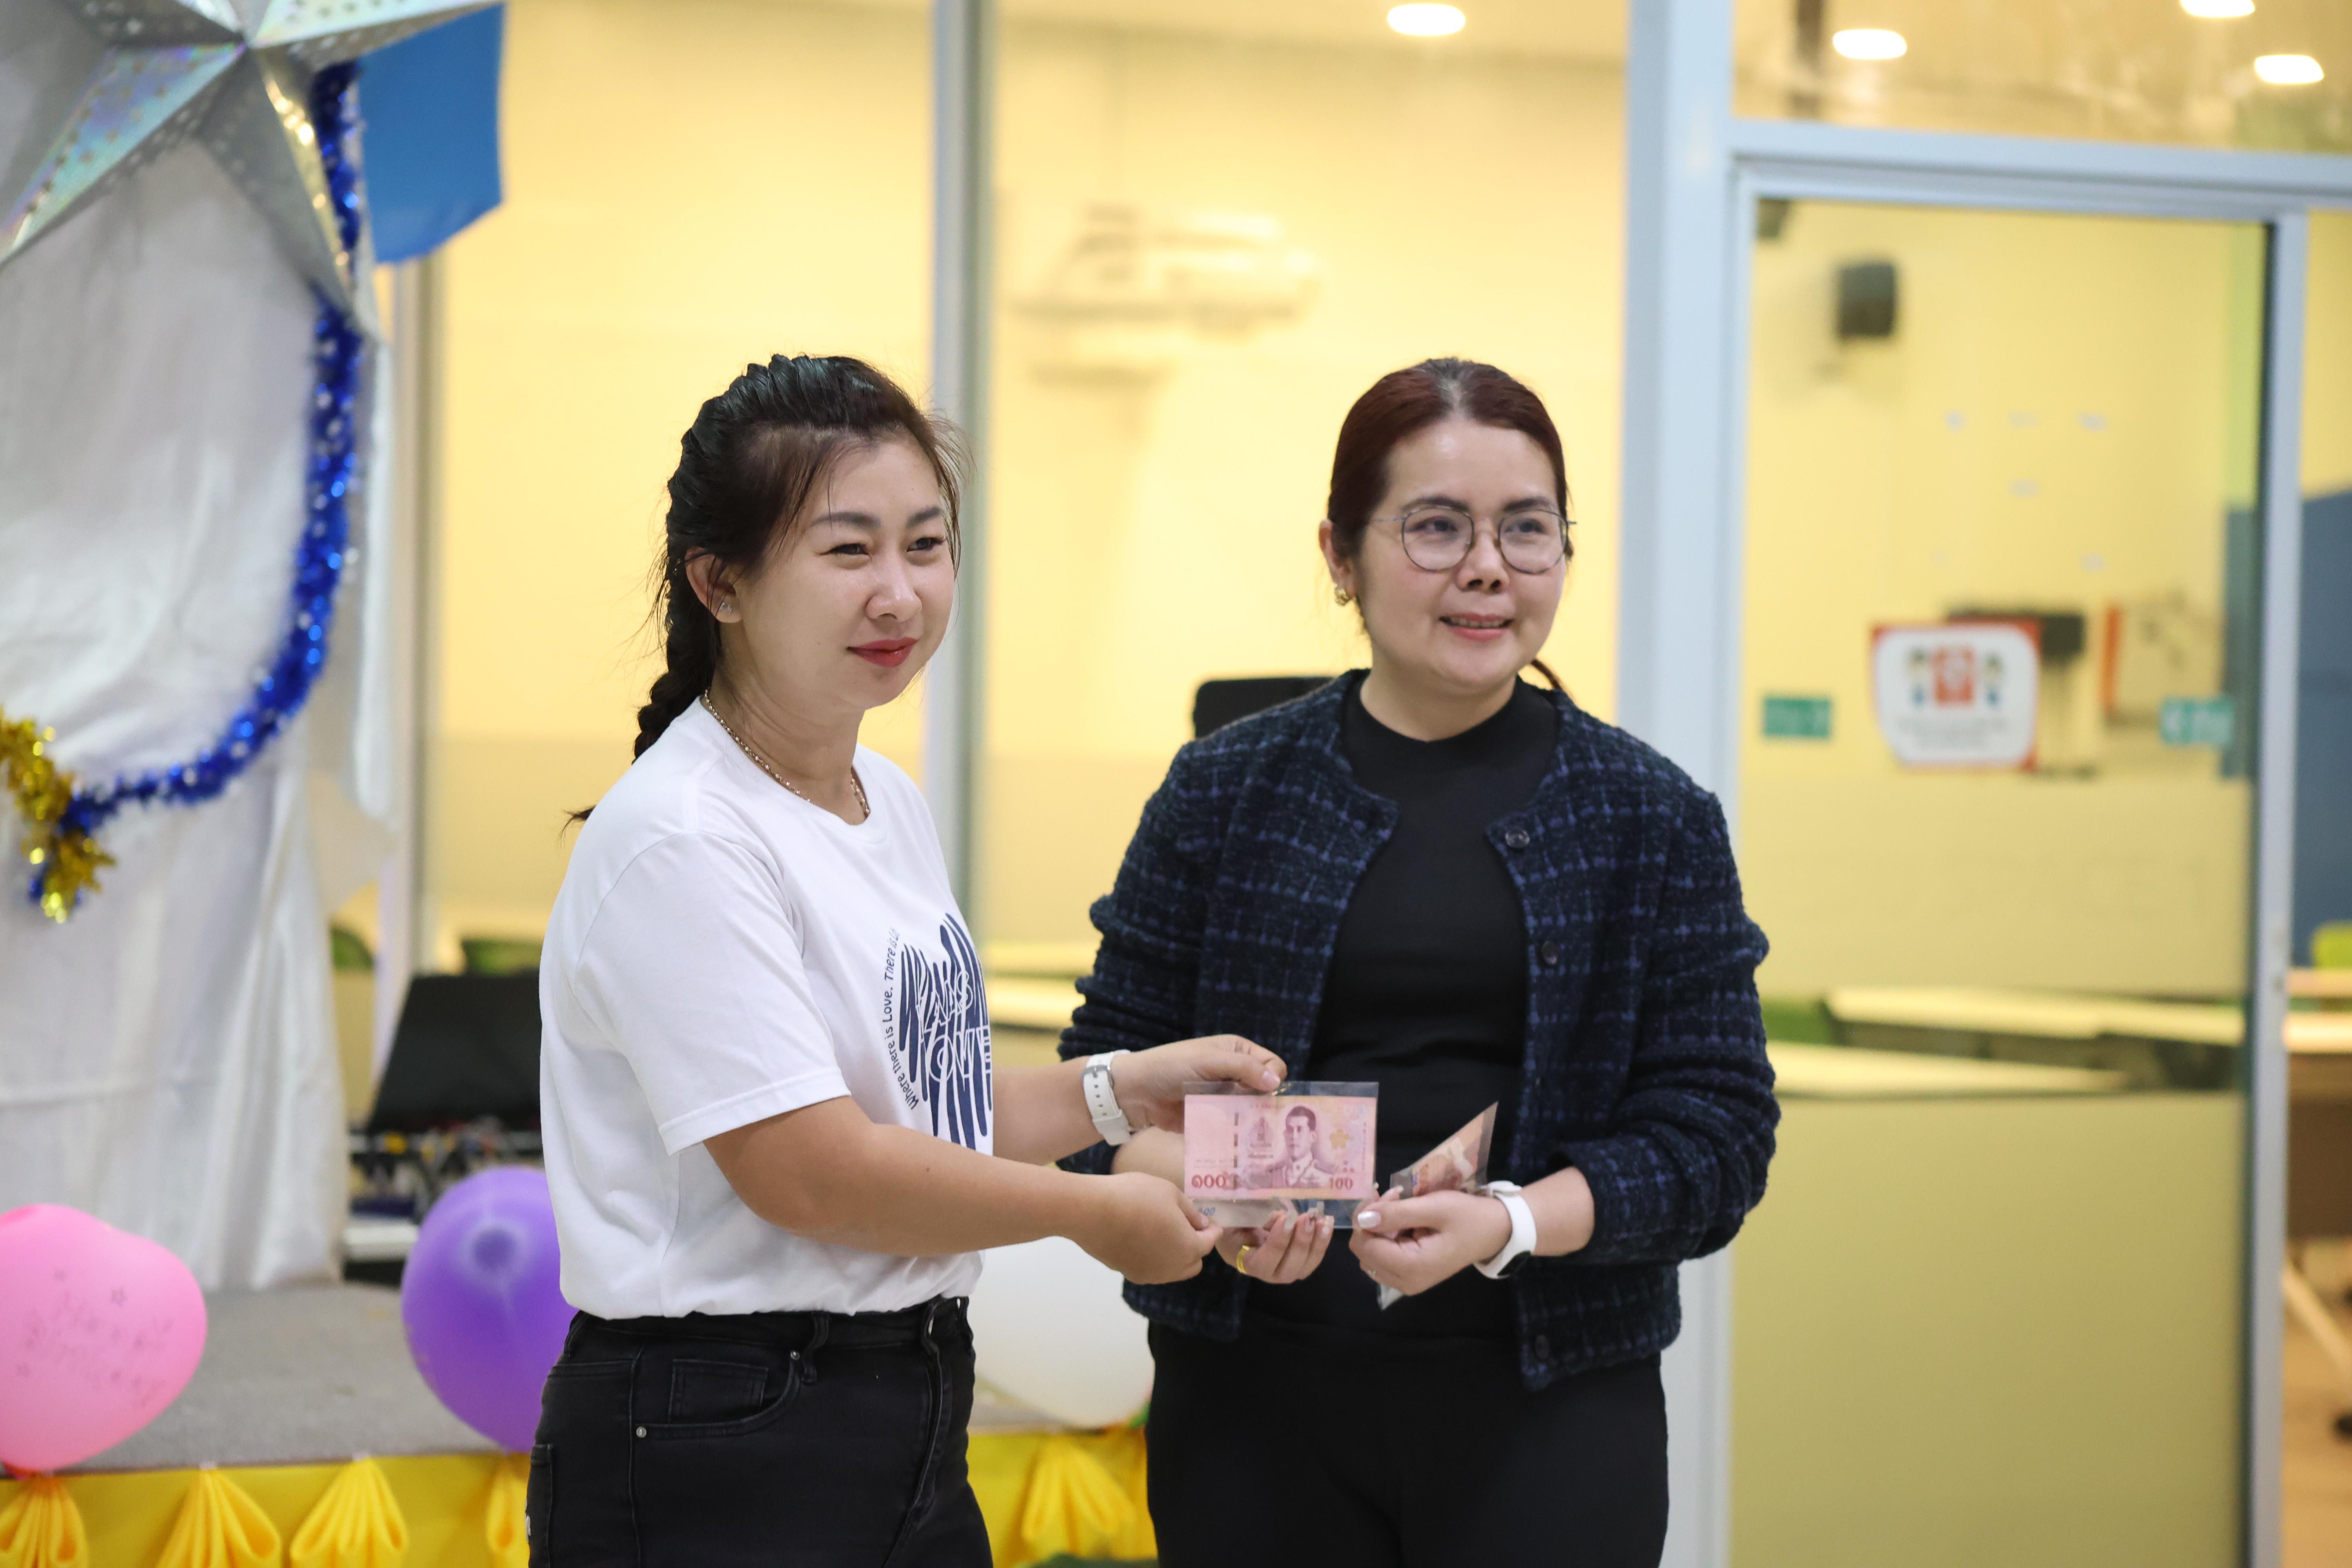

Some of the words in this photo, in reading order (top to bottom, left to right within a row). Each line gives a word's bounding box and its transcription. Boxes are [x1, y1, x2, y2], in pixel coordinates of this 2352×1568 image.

[884, 947, 896, 981] There
[882, 987, 894, 1022] Love.
[884, 1026, 894, 1040] is
[888, 1040, 902, 1074] there
[898, 1073, 919, 1110] Where
[1330, 1178, 1353, 1190] 100
